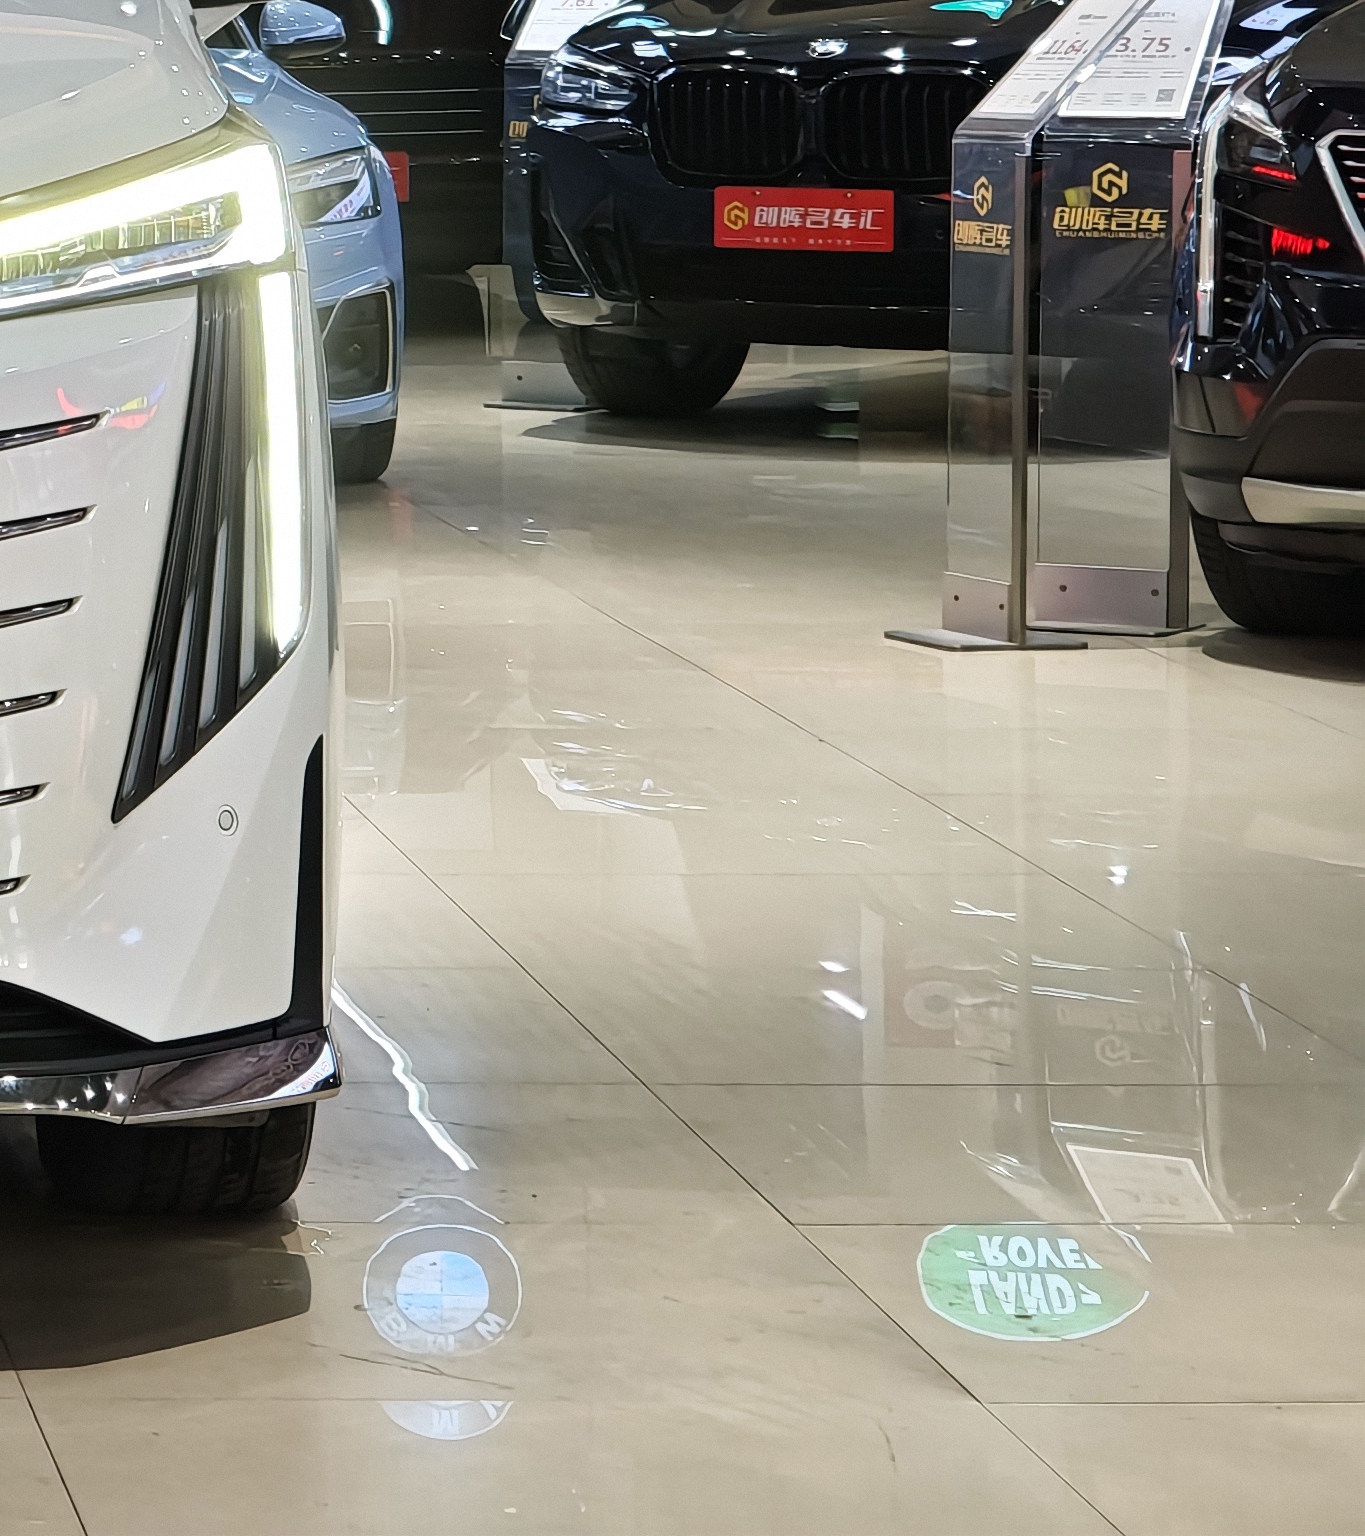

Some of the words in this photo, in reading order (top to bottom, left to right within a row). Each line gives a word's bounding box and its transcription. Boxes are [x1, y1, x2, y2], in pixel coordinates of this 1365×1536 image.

[1115, 37, 1172, 53] 3.75
[754, 206, 885, 230] 创晖名车汇
[1053, 205, 1169, 231] 创晖名车
